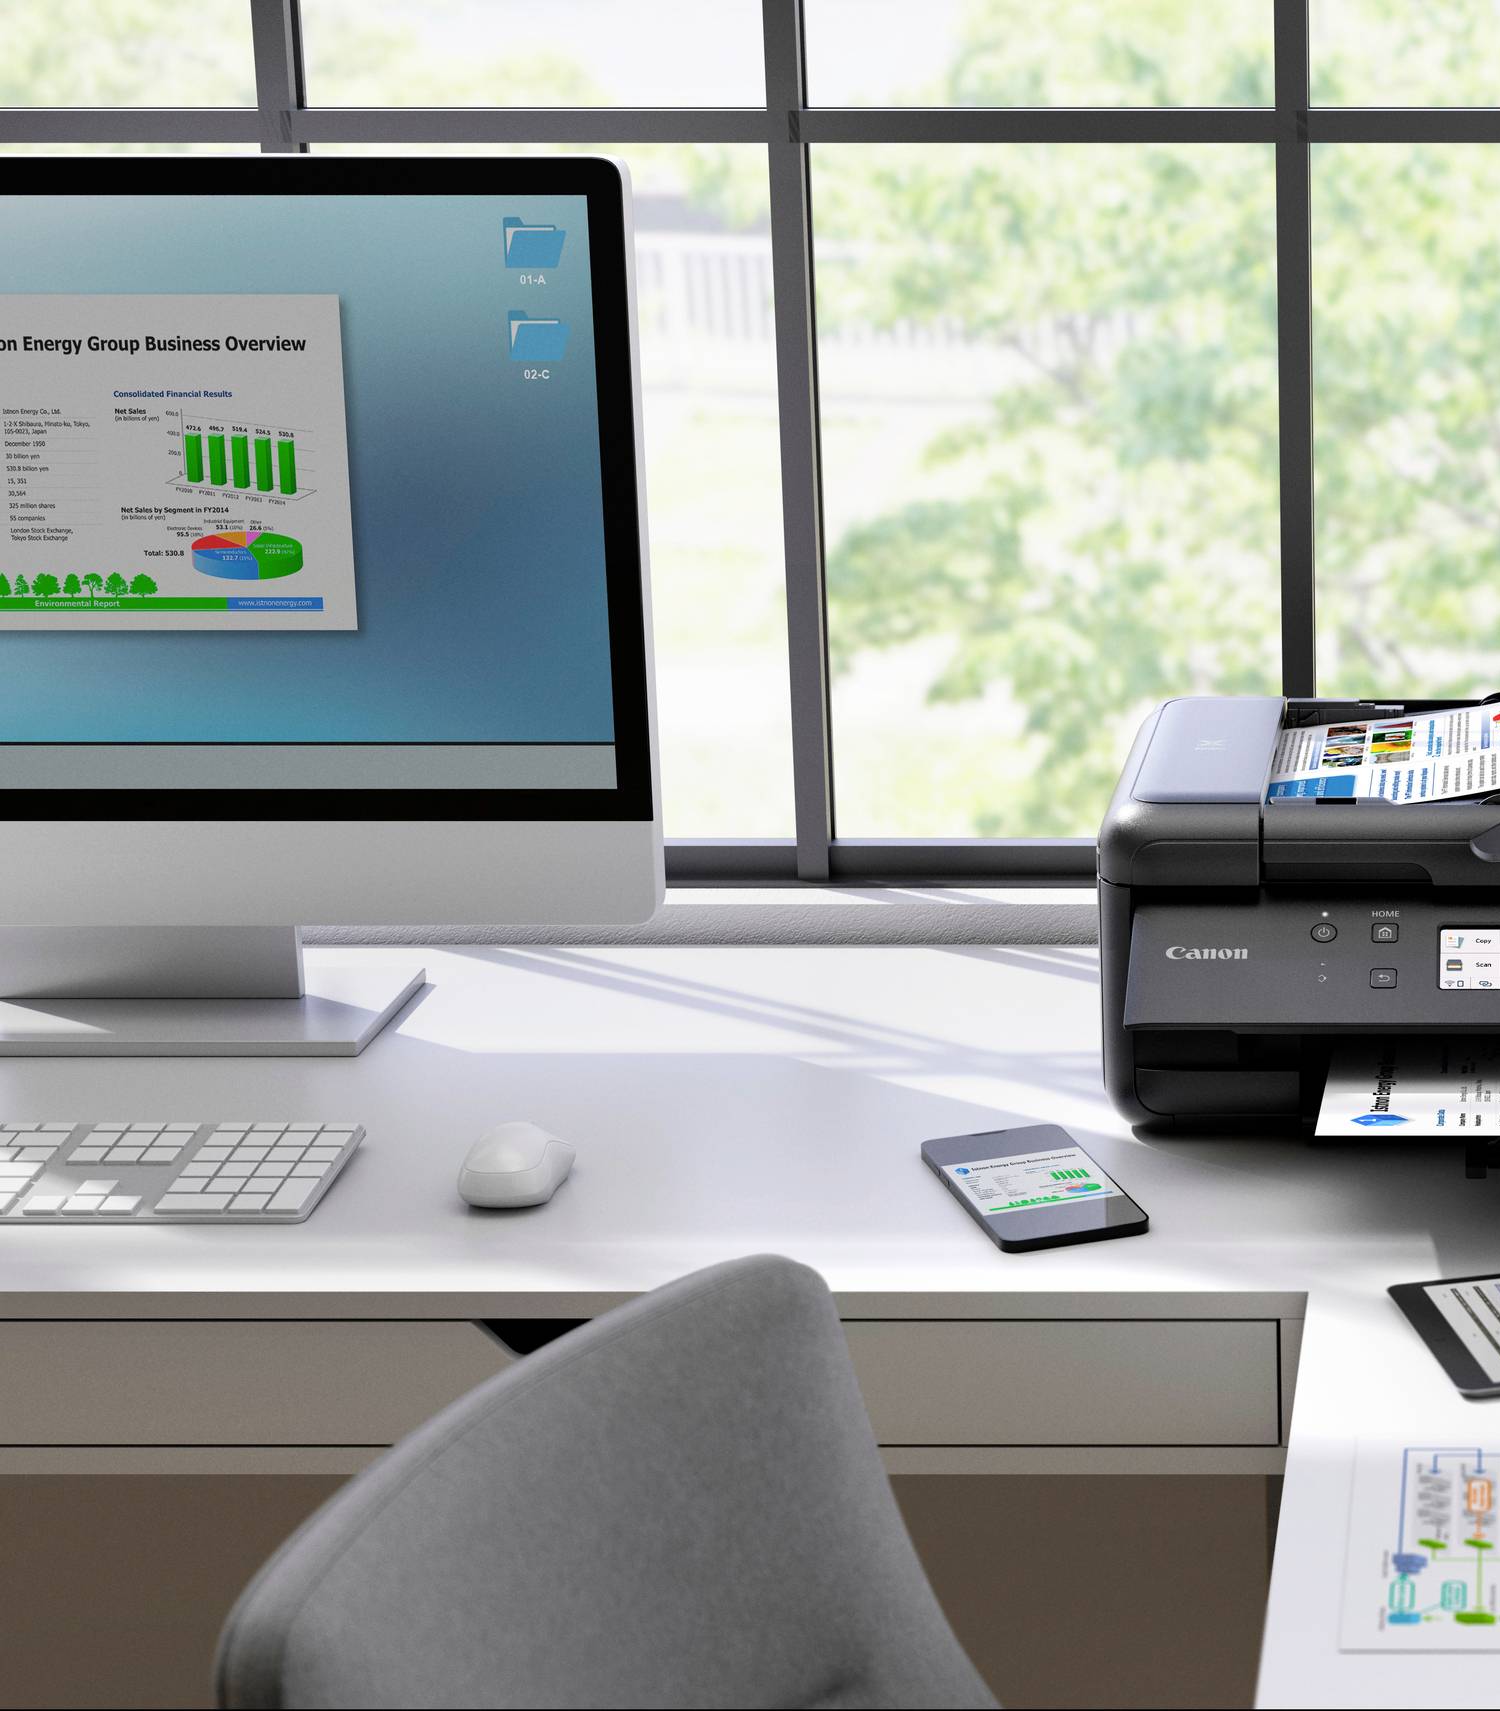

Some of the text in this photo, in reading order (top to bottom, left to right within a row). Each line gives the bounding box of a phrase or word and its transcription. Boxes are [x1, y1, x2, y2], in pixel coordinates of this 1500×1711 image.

[520, 274, 546, 285] 01-A
[23, 336, 82, 355] Energy
[87, 336, 140, 355] Group
[145, 335, 220, 352] Business
[225, 335, 306, 352] Overview
[524, 369, 550, 380] 02-C
[113, 390, 233, 398] Consolidated Financial Results
[121, 506, 229, 515] Net Sales by Segment in FY2014
[143, 549, 185, 557] Total: 530.8
[35, 599, 121, 609] Environmental Report
[1371, 910, 1400, 918] HOME
[1165, 946, 1249, 960] Canon
